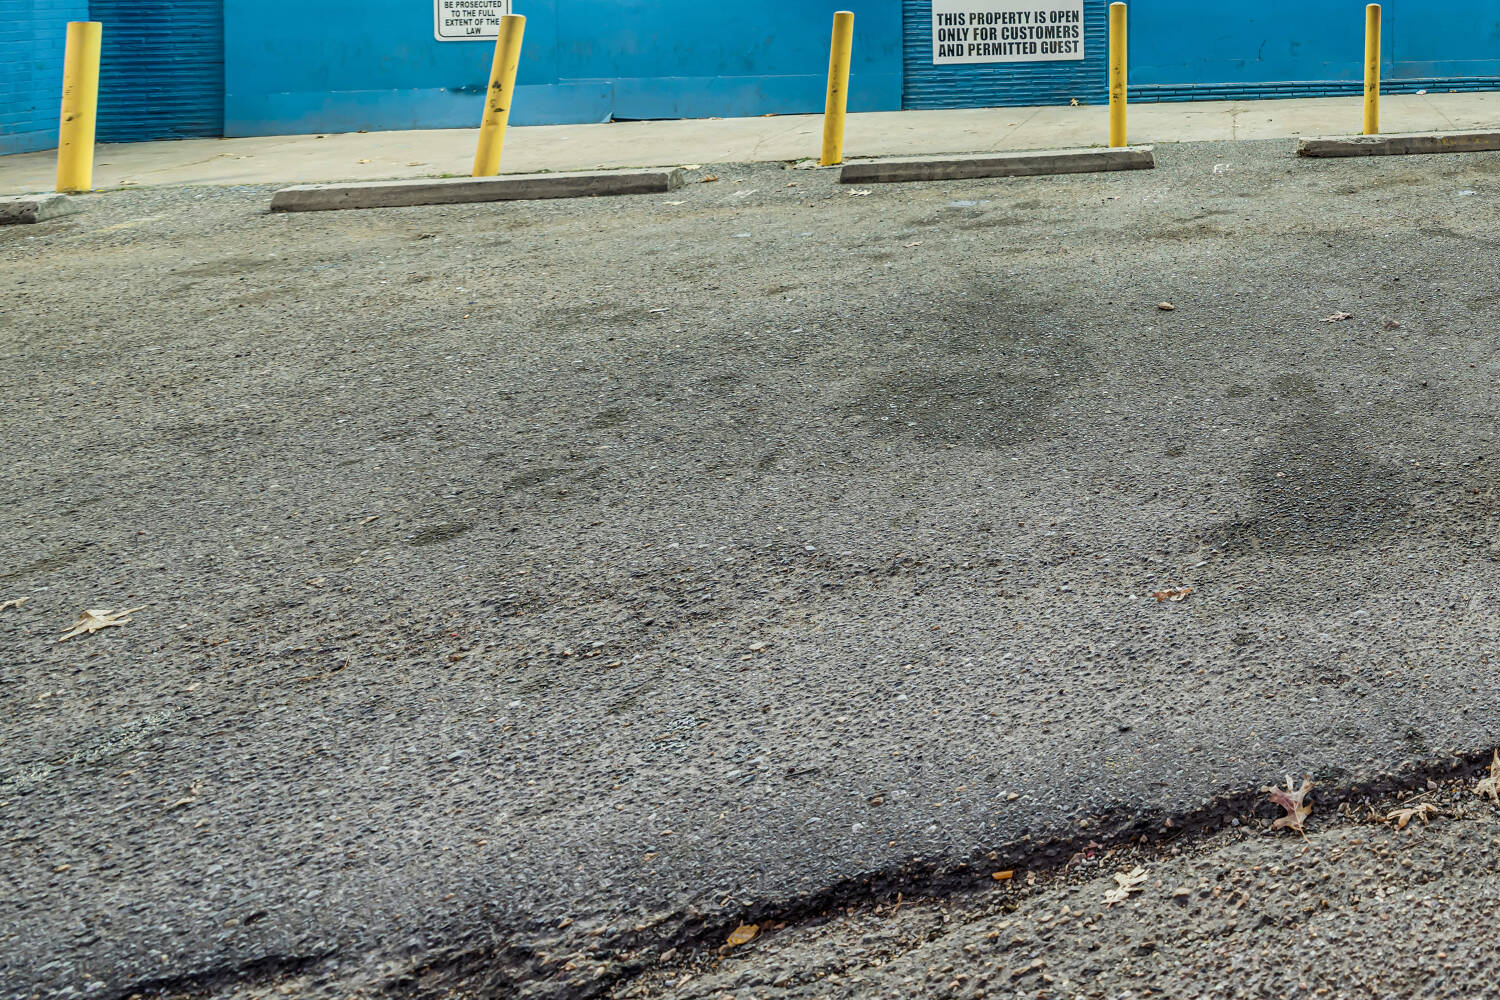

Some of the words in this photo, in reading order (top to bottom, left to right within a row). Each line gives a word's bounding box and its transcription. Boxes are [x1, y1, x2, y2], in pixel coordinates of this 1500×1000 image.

[936, 12, 966, 26] THIS
[969, 11, 1031, 26] PROPERTY
[1034, 10, 1047, 24] IS
[1049, 10, 1080, 24] OPEN
[937, 27, 970, 42] ONLY
[972, 26, 998, 41] FOR
[1001, 24, 1080, 41] CUSTOMERS
[938, 43, 964, 57] AND
[967, 41, 1037, 57] PERMITTED
[1040, 40, 1080, 55] GUEST
